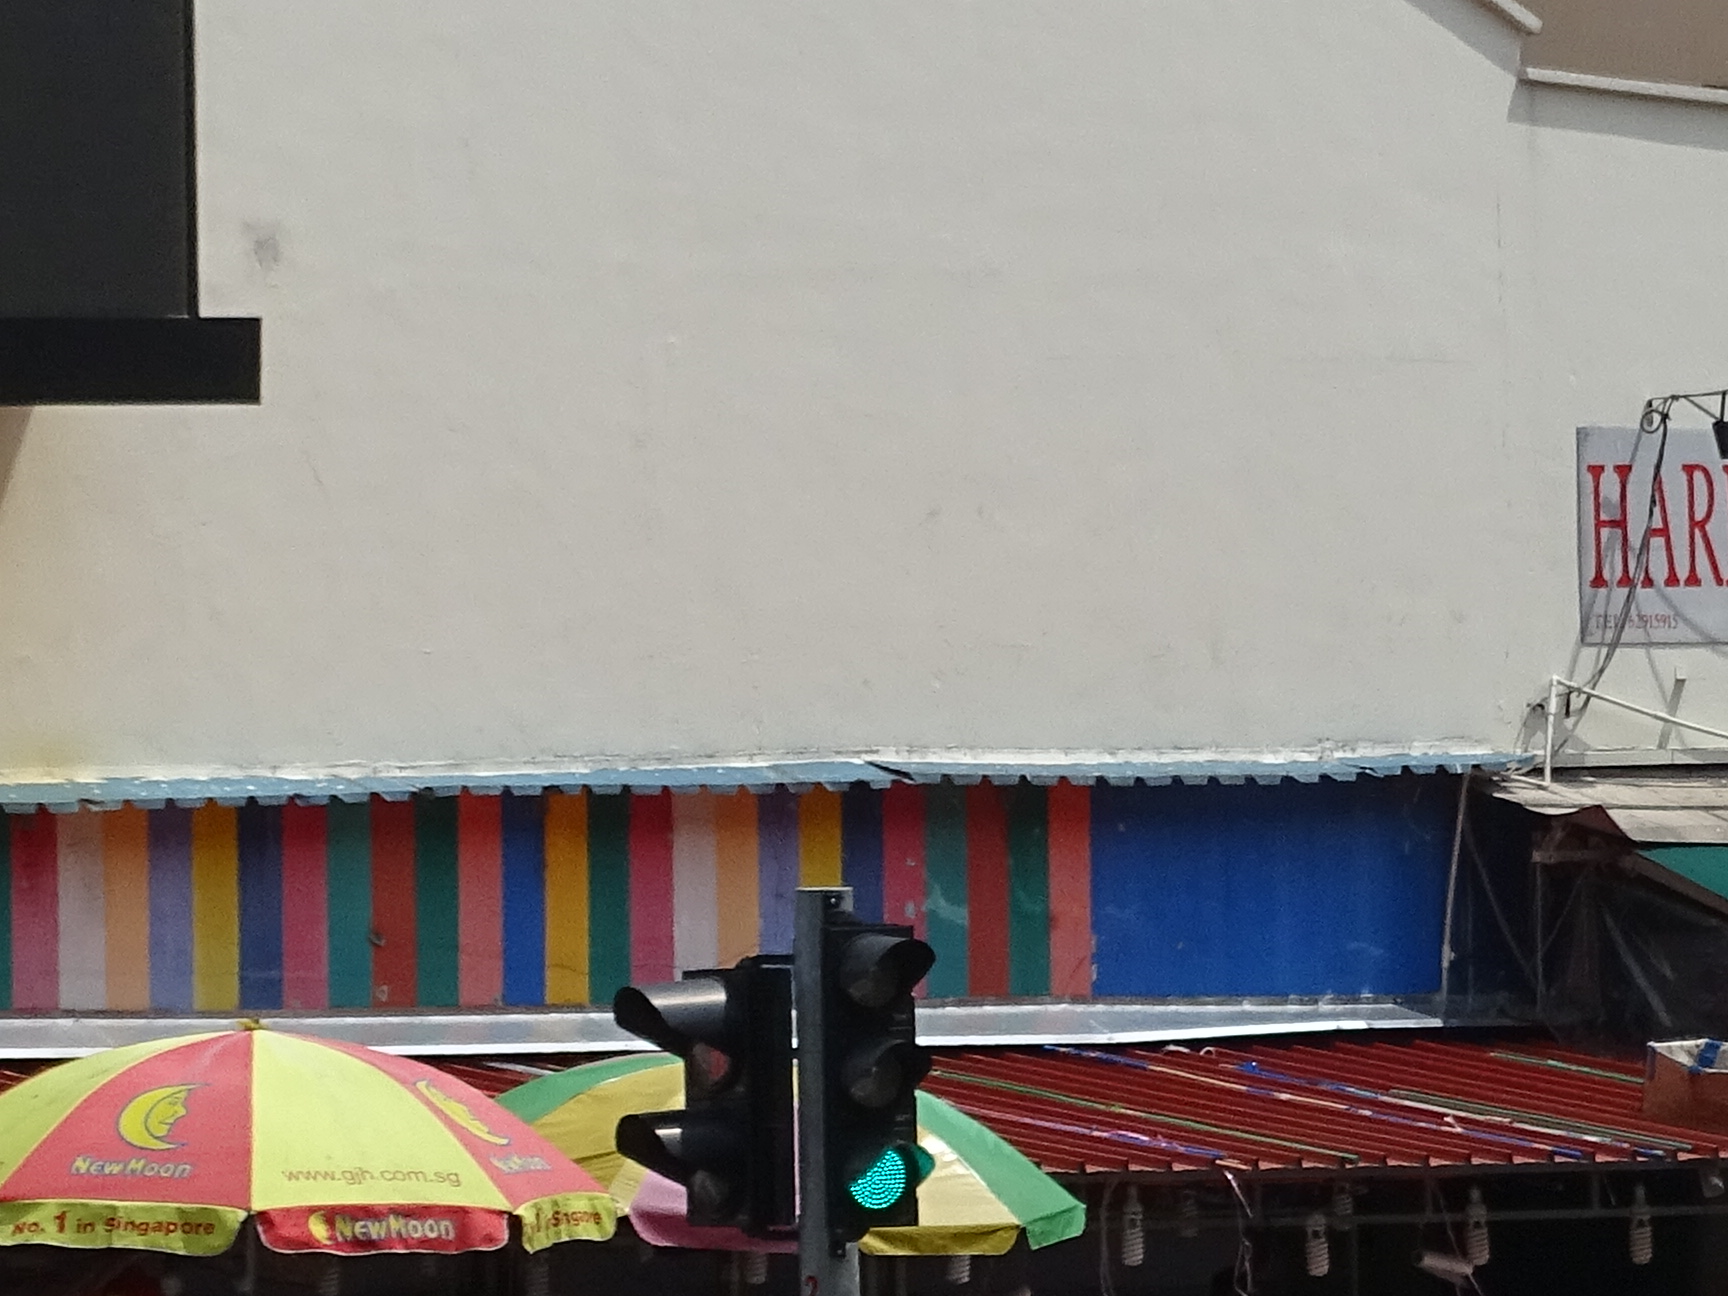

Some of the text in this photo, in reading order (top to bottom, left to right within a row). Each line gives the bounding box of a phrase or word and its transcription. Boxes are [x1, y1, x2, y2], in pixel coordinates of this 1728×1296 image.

[282, 1168, 462, 1188] www.gjh.com.sg
[53, 1209, 69, 1234] 1
[76, 1219, 96, 1236] in
[103, 1215, 217, 1240] Singapore
